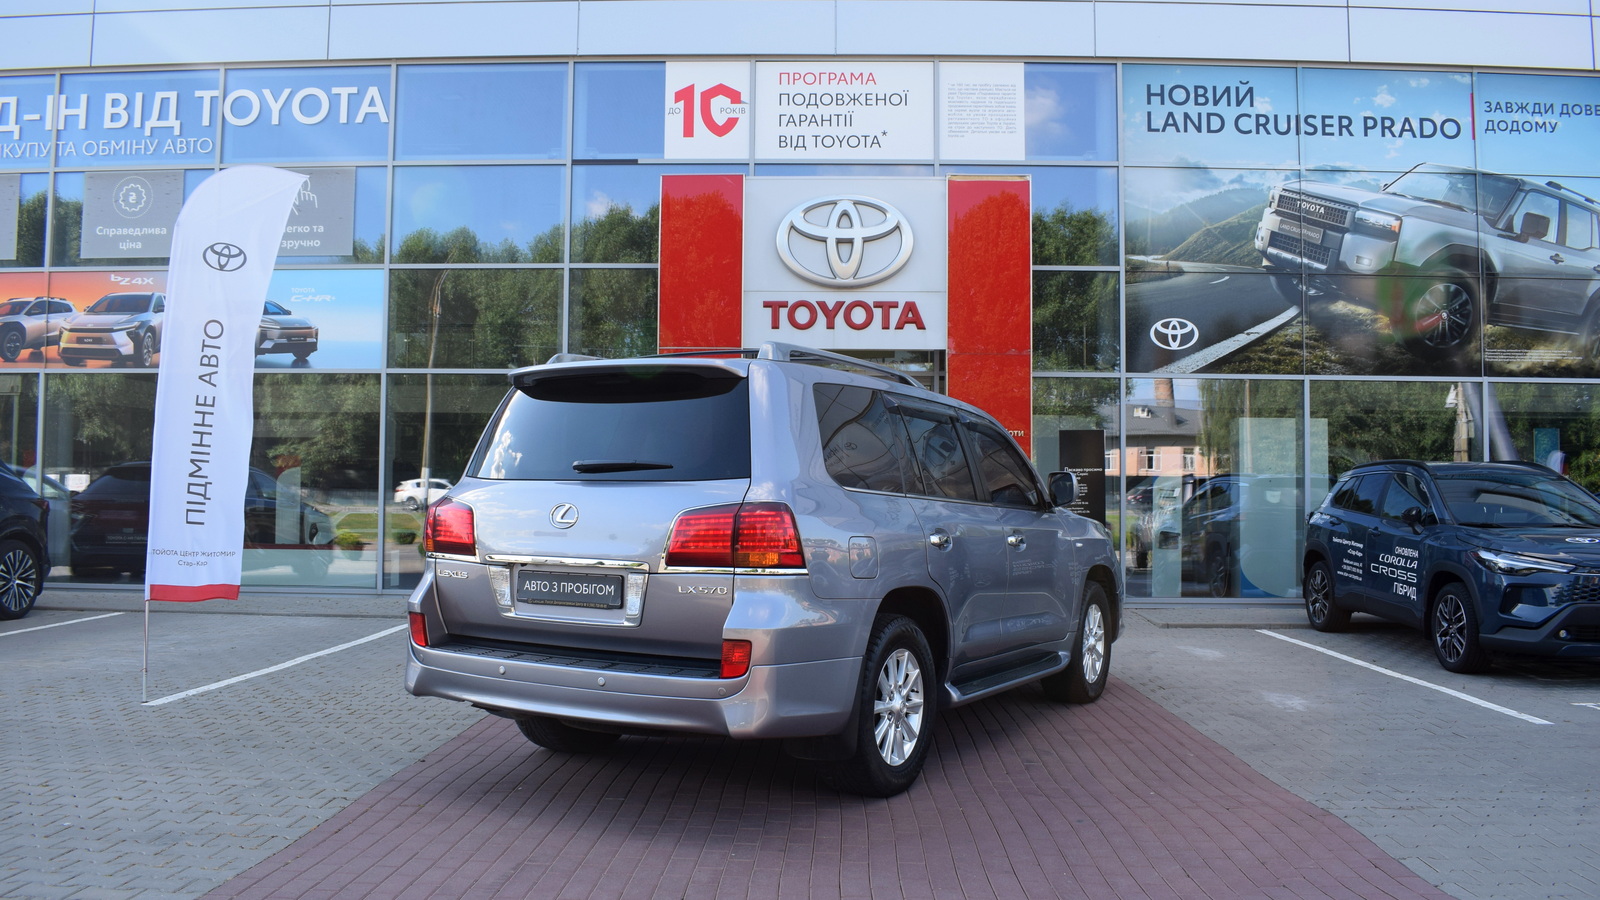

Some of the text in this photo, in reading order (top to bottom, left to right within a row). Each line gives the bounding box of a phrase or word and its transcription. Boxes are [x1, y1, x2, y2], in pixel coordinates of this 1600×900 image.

[778, 72, 877, 86] ПРОГРАМА
[778, 90, 909, 108] ПОДОВЖЕНОЇ
[1146, 81, 1255, 108] НОВИЙ
[104, 90, 181, 136] ВІД
[194, 86, 389, 127] TOYOTA
[668, 107, 681, 116] ДО
[720, 107, 746, 115] РОКІВ
[1484, 100, 1555, 117] ЗАВЖДИ
[779, 111, 854, 127] ГАРАНТІЇ
[1146, 110, 1462, 140] LAND CRUISER PRADO
[1484, 119, 1558, 135] ДОДОМУ
[0, 138, 213, 158] КУПУ ТА ОБМІНУ АВТО
[777, 135, 808, 151] ВІД
[1297, 201, 1325, 214] TOYOTA
[96, 226, 167, 238] Справедлива
[312, 225, 324, 233] та
[119, 239, 142, 250] ціна
[281, 239, 321, 250] зручно
[763, 299, 926, 331] TOYOTA
[186, 319, 224, 526] ПІДМІННЕ АВТО
[1006, 429, 1024, 437] оти
[152, 548, 178, 556] ТОЙОТА
[1394, 546, 1419, 558] ОНОВЛЕНА
[1379, 553, 1418, 569] COROLLA
[438, 569, 468, 579] LEXUS
[1370, 563, 1417, 583] CROSS
[523, 580, 615, 596] АВТО З ПРОБІГОМ
[678, 585, 728, 595] LX 570
